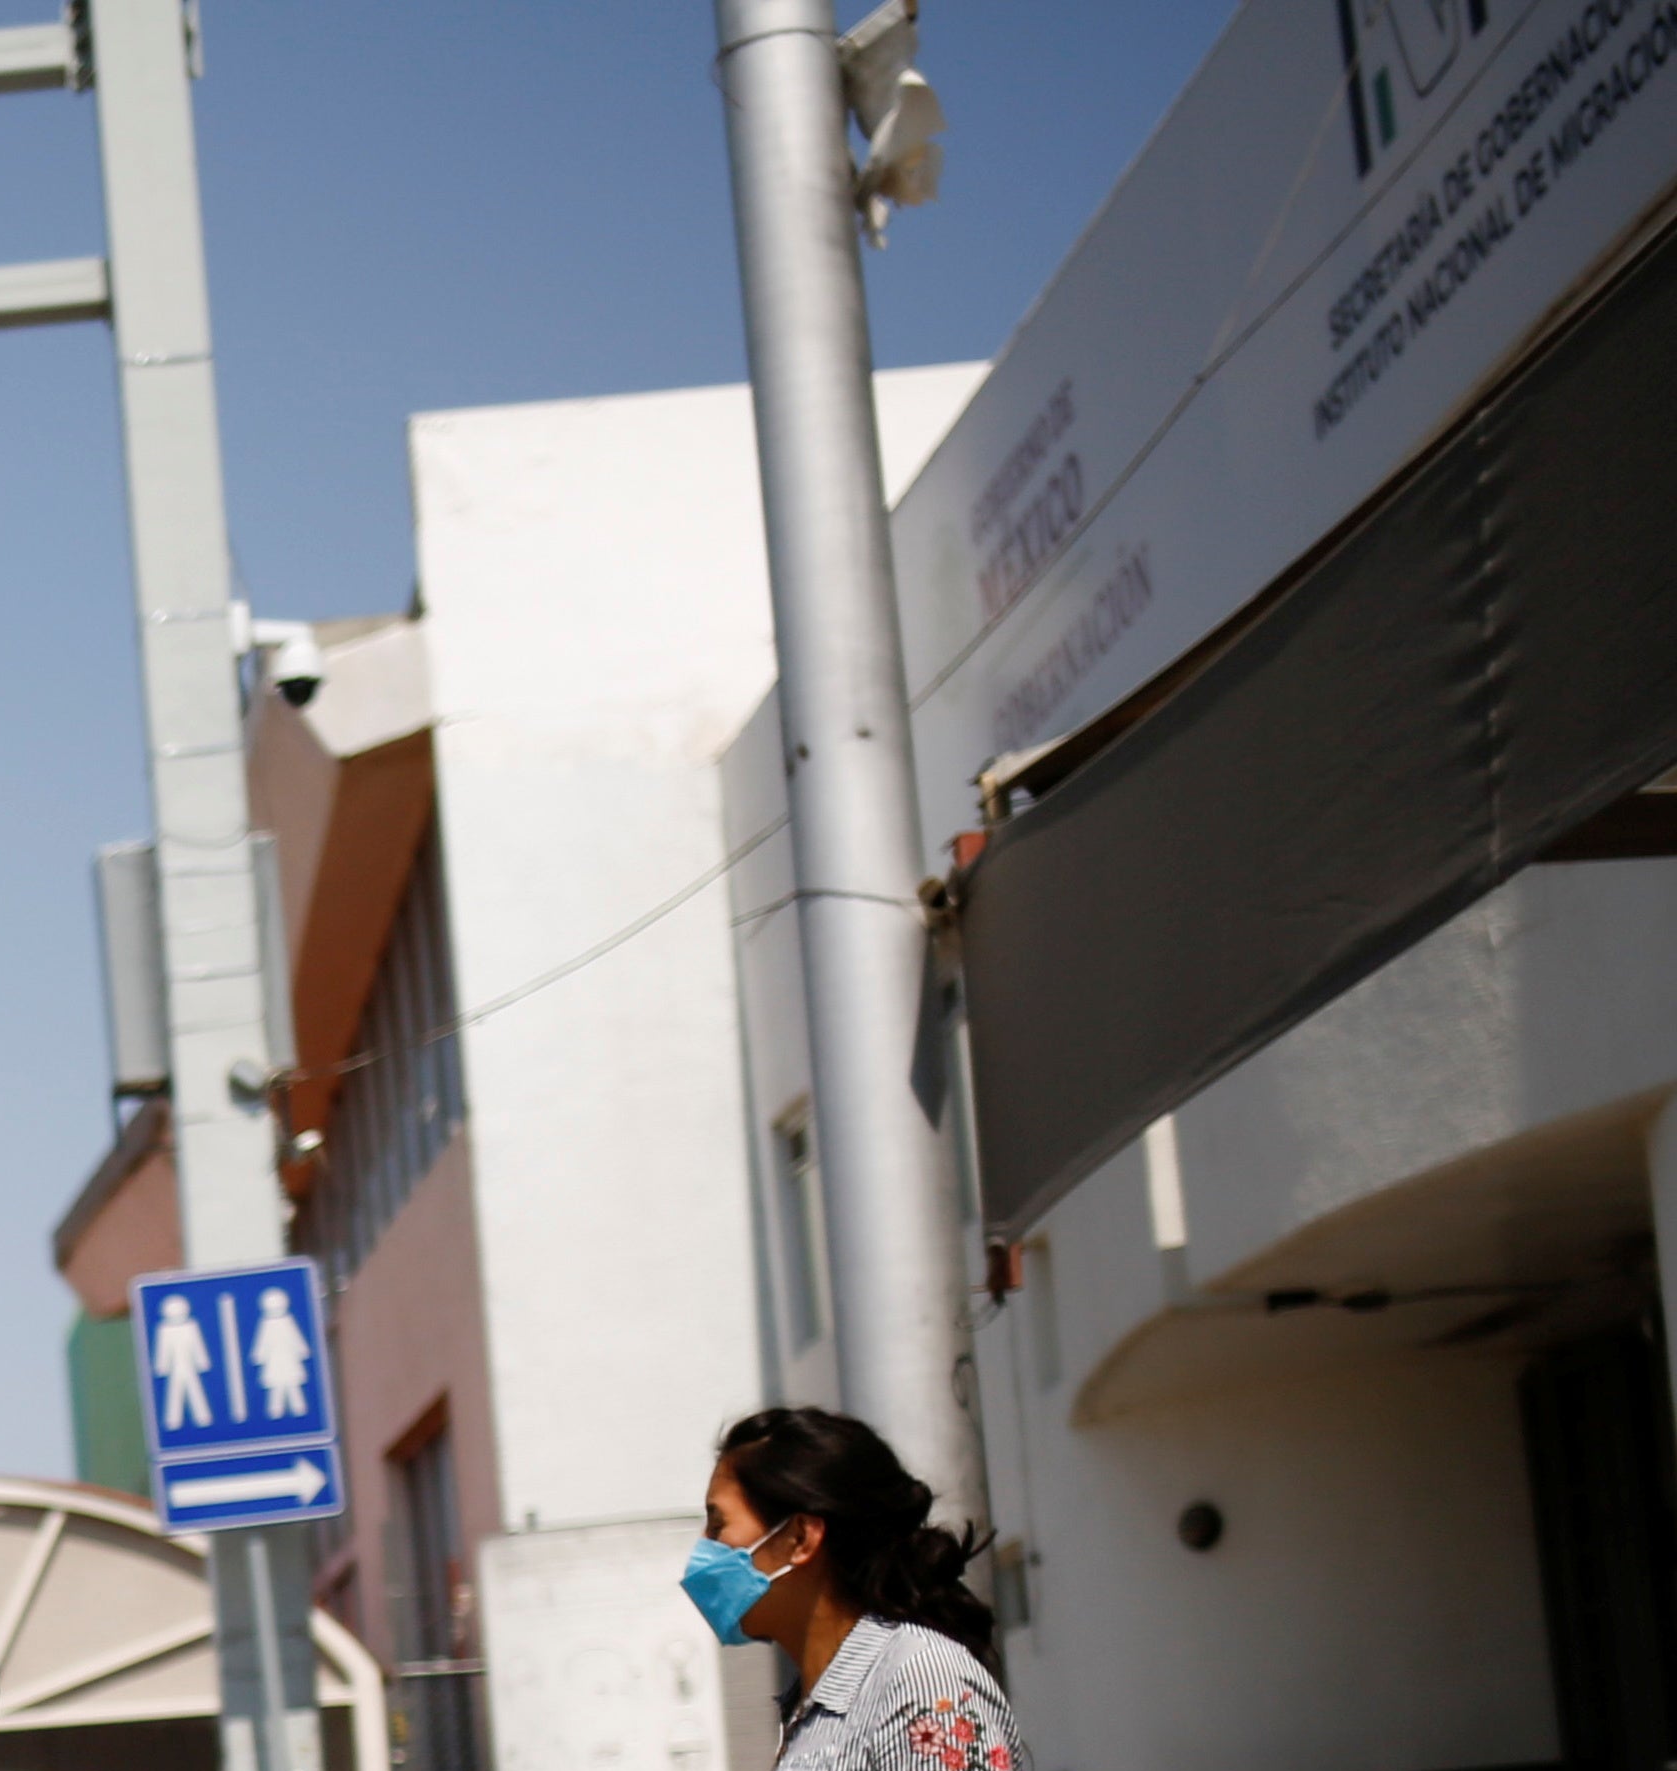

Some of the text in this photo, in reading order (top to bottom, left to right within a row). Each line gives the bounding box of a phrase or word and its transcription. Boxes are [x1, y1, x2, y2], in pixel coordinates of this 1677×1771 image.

[1312, 311, 1406, 441] INSTITUTO
[1406, 198, 1515, 339] NACIONAL
[1514, 150, 1549, 217] DE
[1328, 192, 1442, 352] SECRETARÍA
[1442, 152, 1476, 217] DE
[1476, 0, 1633, 176] GOBERNACI
